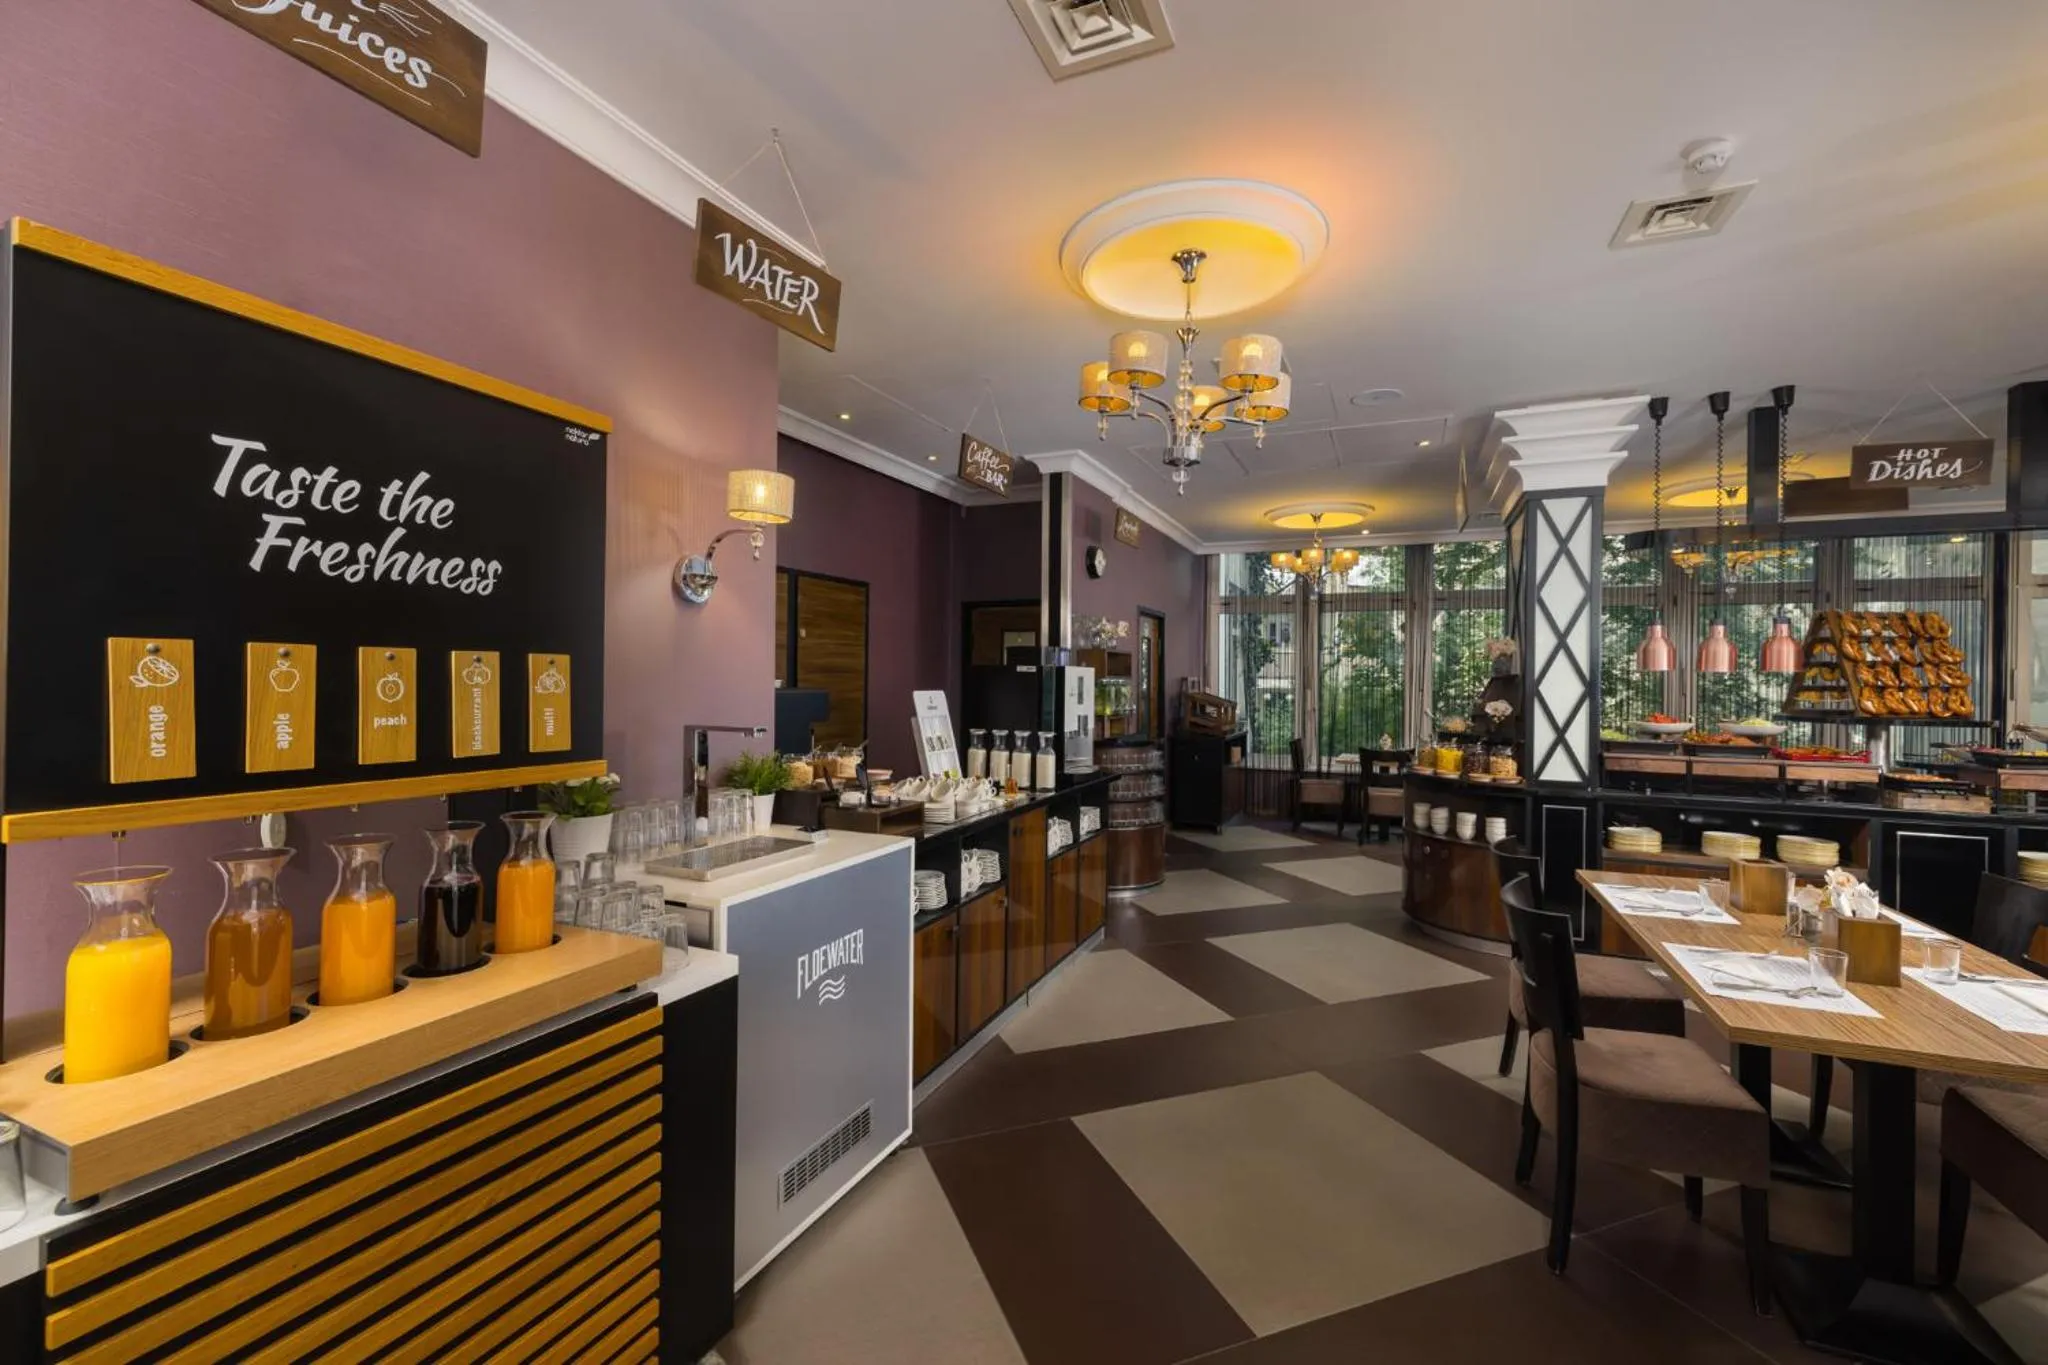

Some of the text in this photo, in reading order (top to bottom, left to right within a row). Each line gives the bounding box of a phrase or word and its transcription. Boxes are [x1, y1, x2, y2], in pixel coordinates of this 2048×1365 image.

[714, 232, 825, 335] WATER
[967, 441, 1009, 472] Coffee
[1867, 457, 1963, 482] Dishes
[1895, 447, 1948, 461] HOT
[211, 433, 455, 529] Taste the
[985, 468, 1006, 492] BAR
[248, 513, 502, 596] Freshness
[149, 704, 169, 758] orange
[273, 712, 294, 750] apple
[373, 713, 407, 729] peach
[471, 687, 482, 751] blackcurrant
